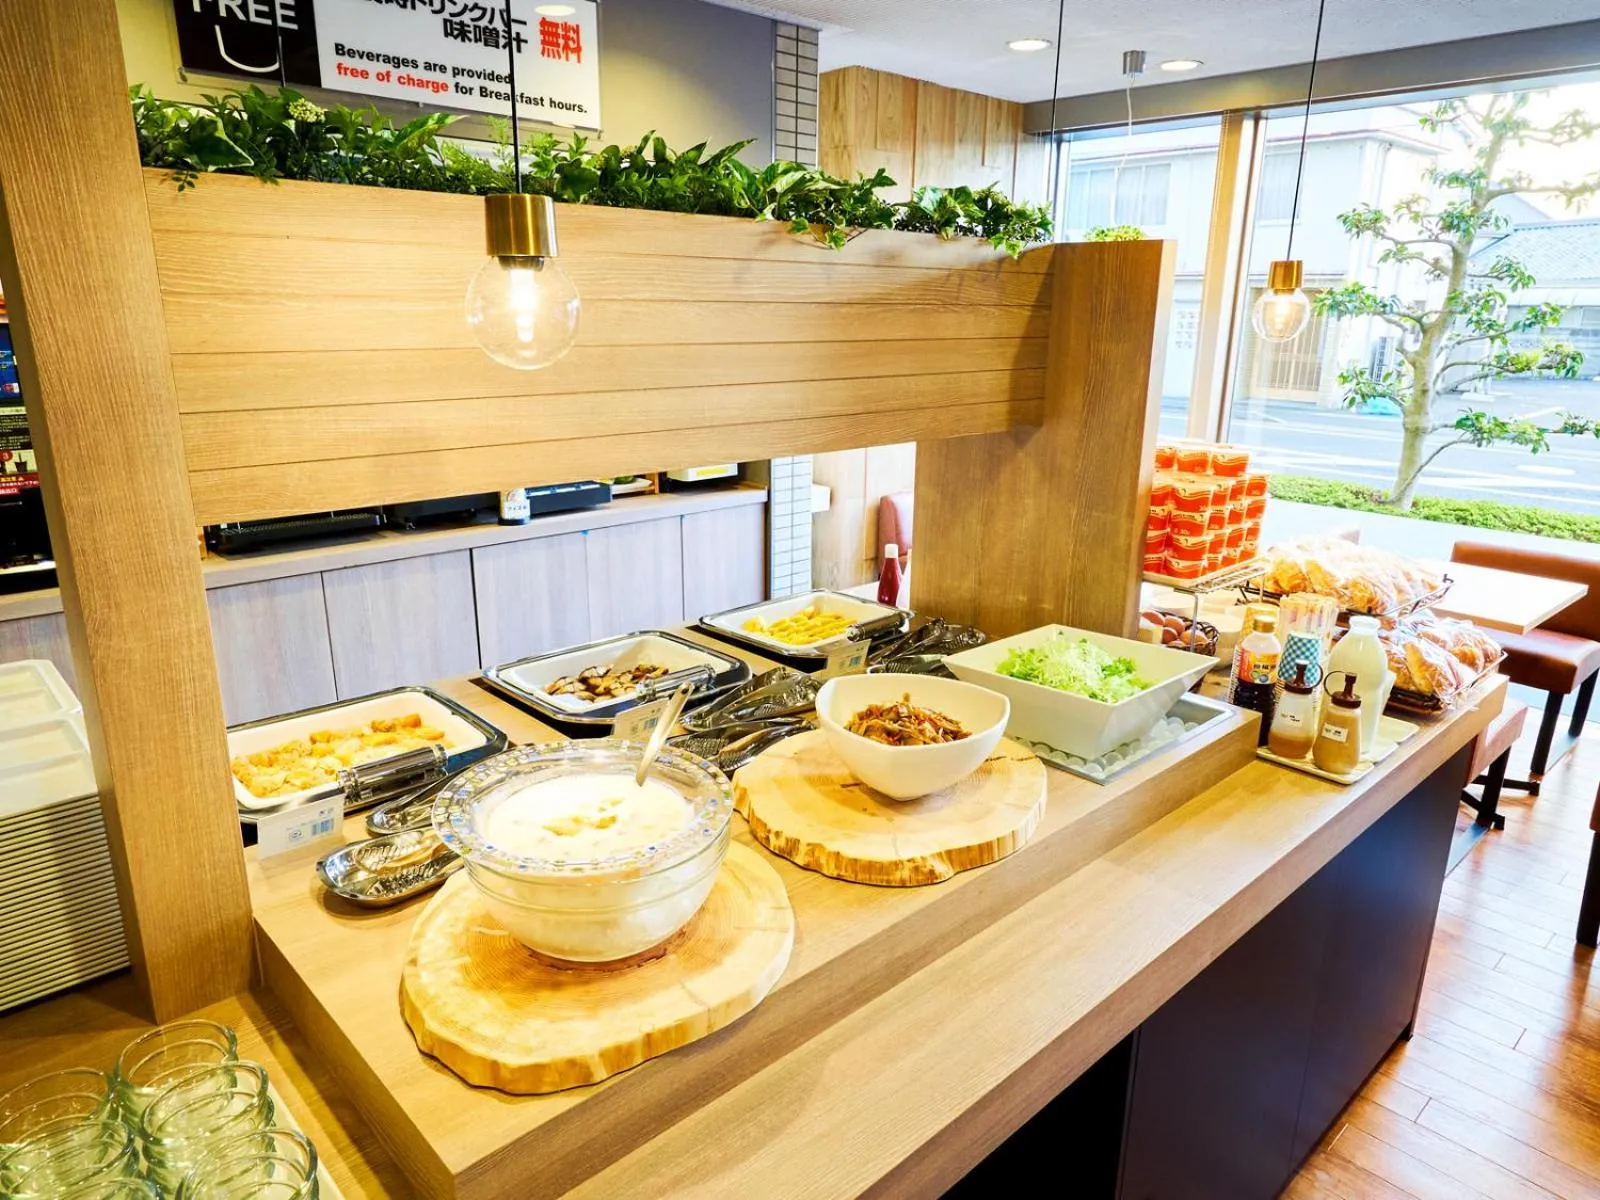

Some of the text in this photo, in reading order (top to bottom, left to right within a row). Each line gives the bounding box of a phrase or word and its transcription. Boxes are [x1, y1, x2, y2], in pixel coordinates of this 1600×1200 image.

[443, 18, 528, 53] 味噌汁
[539, 17, 583, 64] 無料
[335, 43, 513, 84] Beverages are provided
[336, 62, 369, 80] free
[376, 70, 391, 83] of
[397, 74, 449, 93] charge
[454, 81, 474, 96] for
[549, 97, 587, 113] hours.
